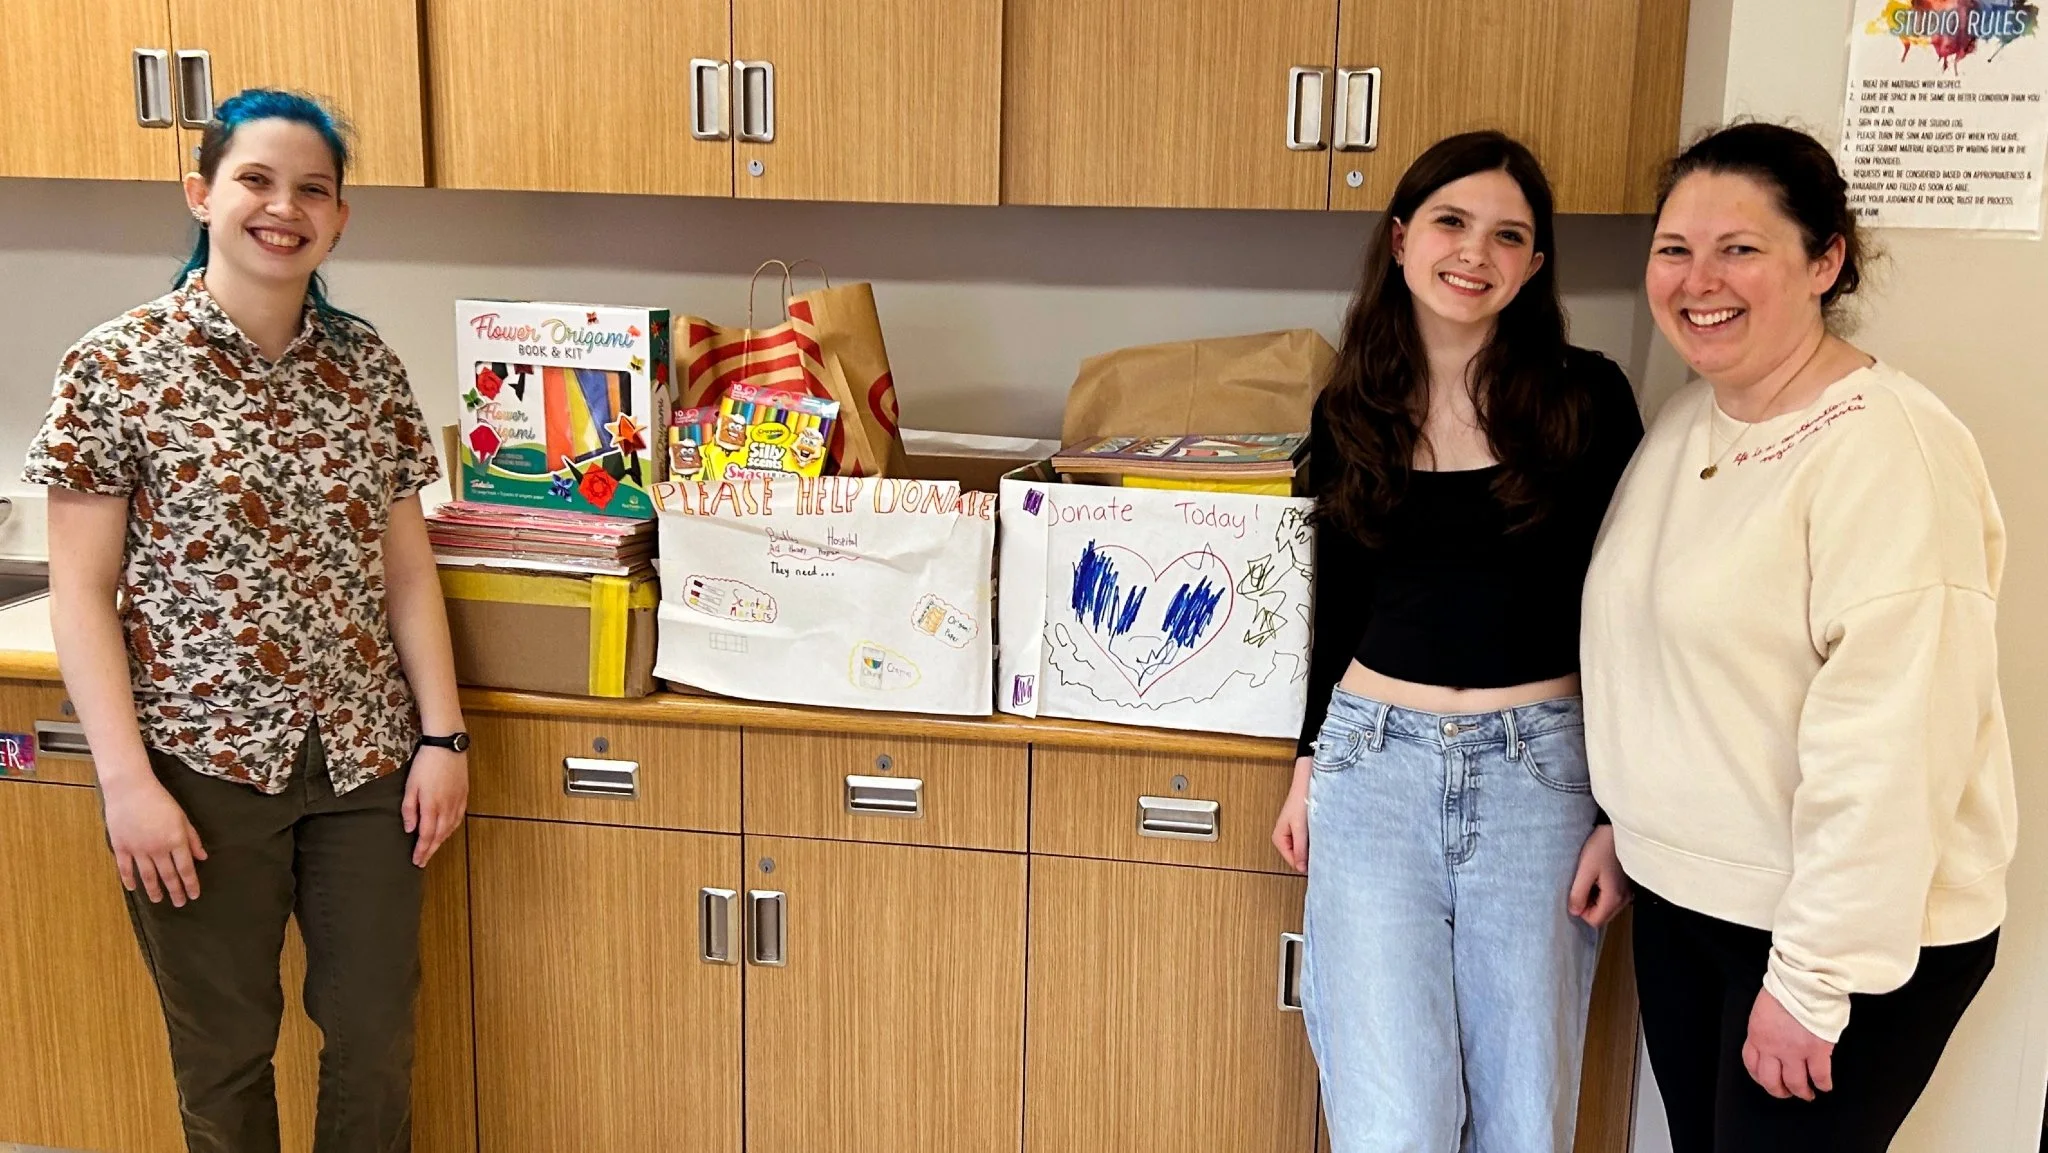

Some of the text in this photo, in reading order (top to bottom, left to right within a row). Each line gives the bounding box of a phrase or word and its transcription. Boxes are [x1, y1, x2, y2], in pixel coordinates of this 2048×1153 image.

[1892, 9, 2028, 36] STUDIO RULES
[1880, 80, 1888, 88] THE
[1892, 80, 1920, 88] MATERIALS
[1861, 93, 1877, 101] LEAVE
[1879, 93, 1888, 101] THE
[1890, 93, 1907, 101] SPACE
[1910, 93, 1916, 101] IN
[1918, 93, 1928, 101] THE
[1930, 93, 1945, 101] SAME
[1948, 93, 1956, 101] OR
[1958, 93, 1976, 101] BETTER
[1978, 93, 2010, 101] CONDITION
[2011, 94, 2026, 102] THAN
[2028, 94, 2040, 102] YOU
[1860, 105, 1880, 114] FOUND
[1881, 105, 1886, 114] IT
[1859, 118, 1872, 126] SIGN
[1874, 118, 1880, 126] IN
[1881, 119, 1893, 127] AND
[1896, 119, 1906, 127] OUT
[1908, 119, 1915, 127] OF
[1918, 119, 1927, 127] THE
[1930, 119, 1950, 127] STUDIO
[1857, 131, 1876, 139] PLEASE
[1879, 131, 1892, 139] TURN
[1895, 131, 1904, 140] THE
[1907, 131, 1919, 140] SINK
[1921, 131, 1933, 140] AND
[1935, 131, 1953, 140] LIGHTS
[1955, 132, 1966, 140] OFF
[1968, 132, 1985, 140] WHEN
[1987, 132, 1999, 140] YOU
[1856, 144, 1875, 152] PLEASE
[1877, 144, 1897, 152] SUBMIT
[1900, 144, 1924, 152] MATERIAL
[1926, 145, 1954, 153] REQUESTS
[1956, 145, 1964, 153] BY
[1991, 145, 2006, 153] THEM
[2008, 145, 2014, 153] IN
[2016, 145, 2026, 153] THE
[1855, 156, 1870, 165] FORM
[1854, 169, 1880, 178] REQUESTS
[1883, 170, 1894, 178] WILL
[1896, 170, 1903, 178] BE
[1906, 170, 1940, 178] CONSIDERED
[1943, 170, 1960, 178] BASED
[1963, 170, 1972, 179] ON
[1973, 171, 2025, 179] APPROPRIATENESS
[2026, 171, 2032, 179] &
[1852, 182, 1884, 190] AVAILABILITY
[1886, 182, 1897, 190] AND
[1900, 182, 1917, 190] FILLED
[1920, 183, 1926, 191] AS
[1928, 183, 1943, 191] SOON
[1946, 183, 1953, 191] AS
[1850, 195, 1866, 203] LEAVE
[1869, 195, 1884, 203] YOUR
[1886, 195, 1916, 203] JUDGMENT
[1917, 195, 1923, 203] AT
[1926, 195, 1934, 203] THE
[1957, 196, 1973, 204] TRUST
[1975, 196, 1985, 204] THE
[470, 312, 635, 353] Flower Origami
[518, 343, 585, 360] BOOK & KIT
[733, 383, 743, 391] 10
[674, 409, 684, 417] 10
[749, 441, 786, 460] Silly
[1732, 451, 1748, 466] life
[747, 457, 783, 470] scents
[651, 475, 995, 520] PLEASE HELP DONATE
[827, 526, 858, 547] Hospital
[770, 561, 790, 578] They
